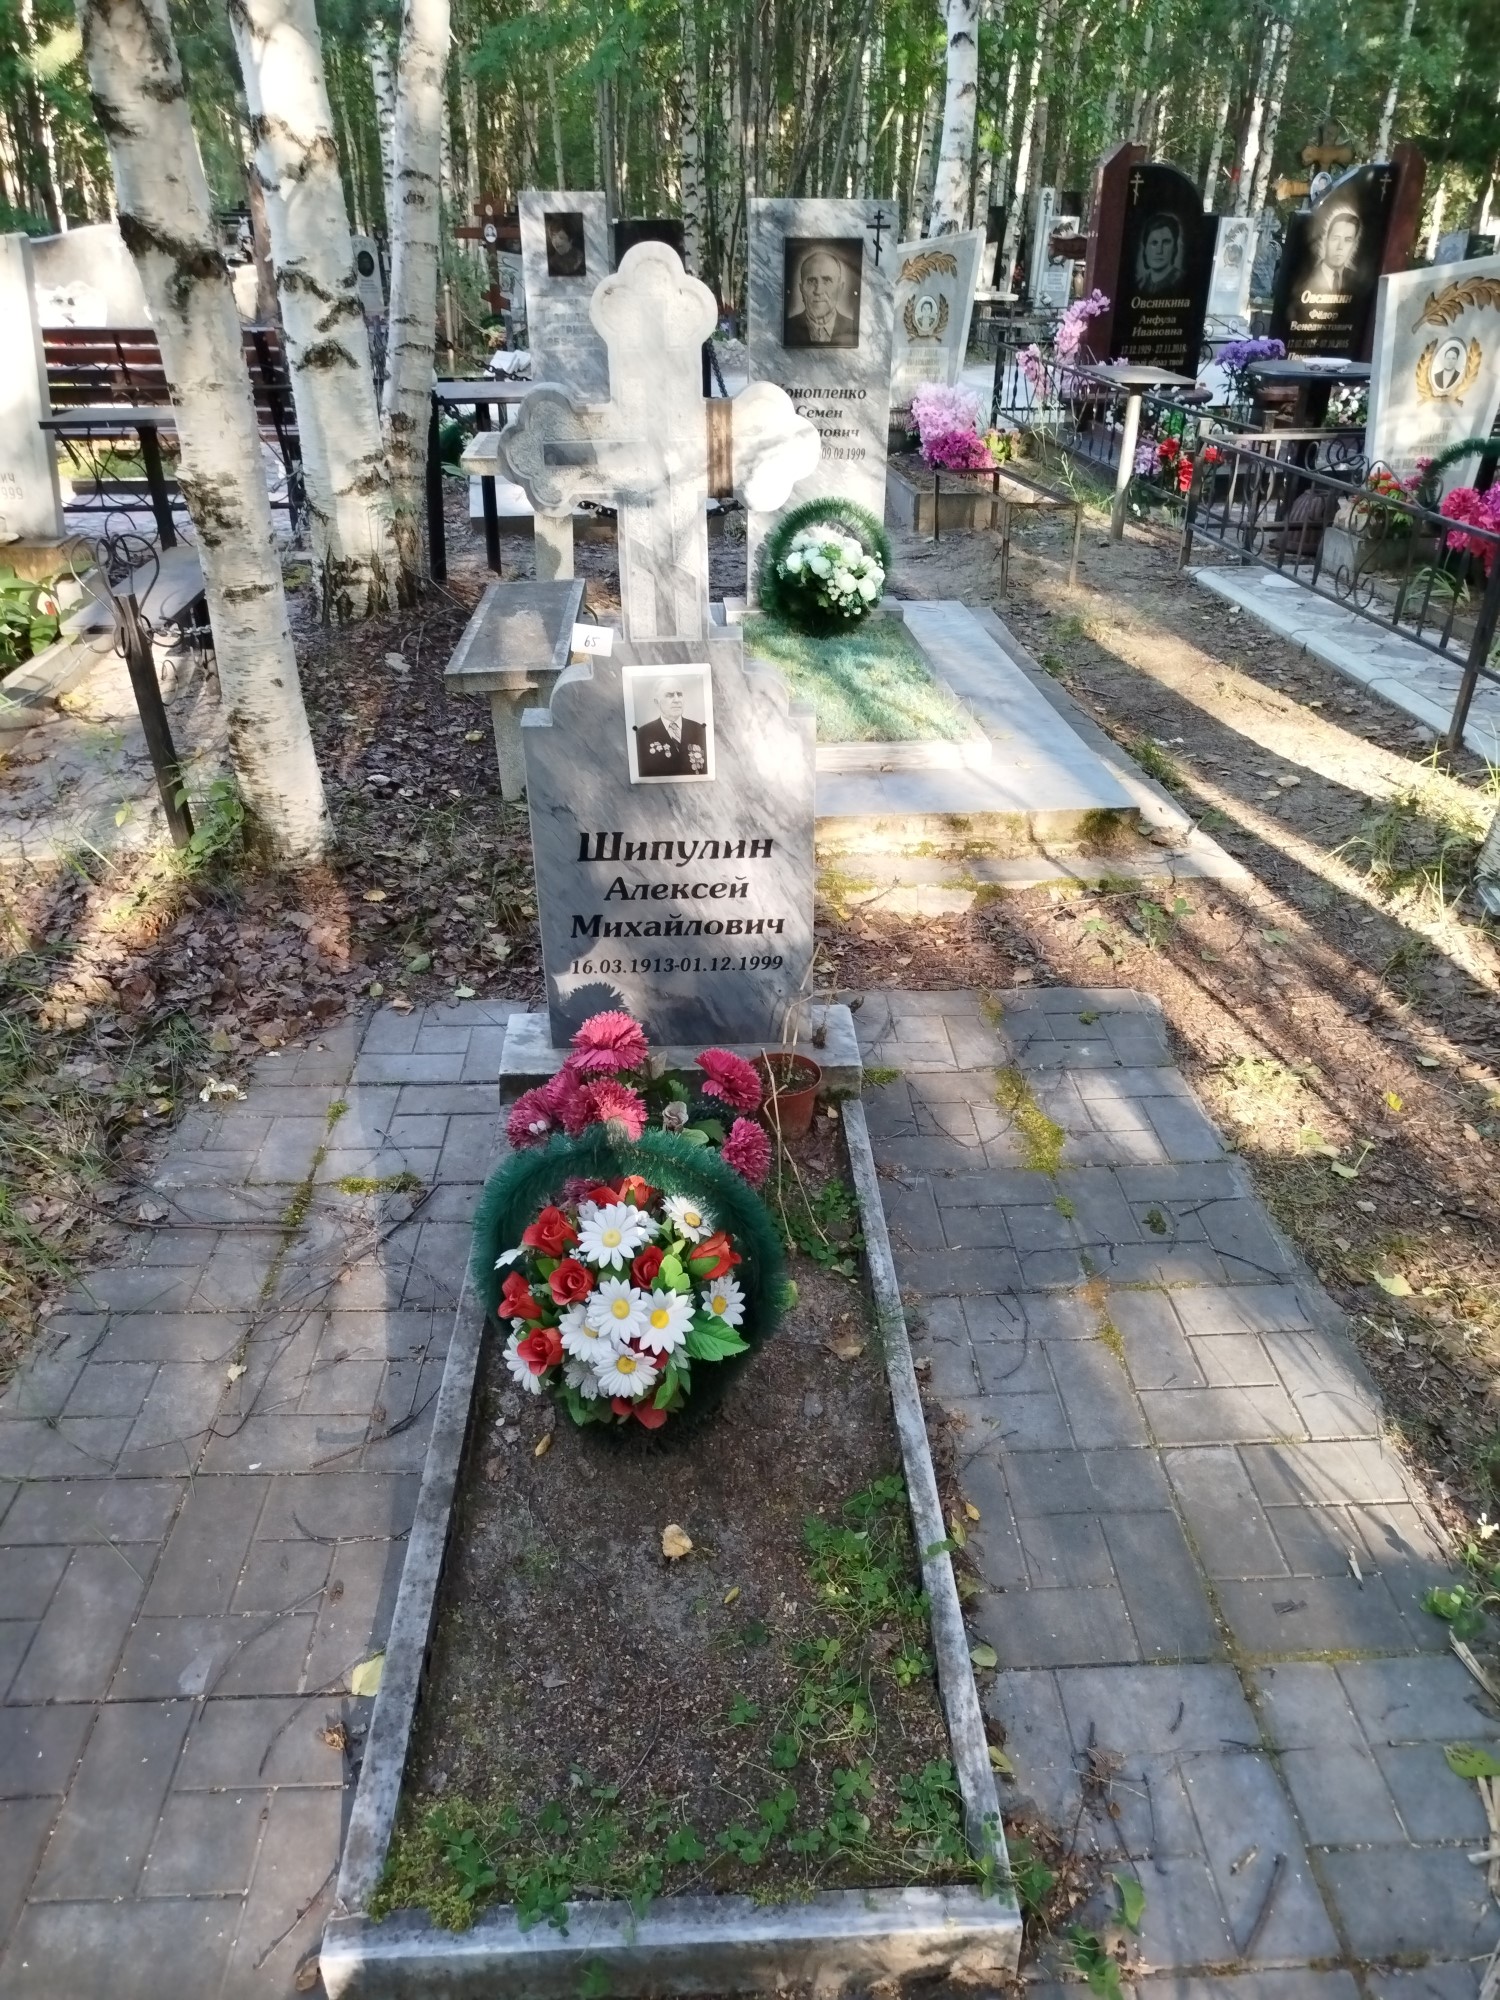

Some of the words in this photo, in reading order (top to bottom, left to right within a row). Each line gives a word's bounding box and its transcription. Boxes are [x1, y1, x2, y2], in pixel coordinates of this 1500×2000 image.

[1131, 296, 1190, 309] Овсянкина
[1132, 327, 1183, 337] Ивановна
[796, 405, 843, 418] Семен
[584, 635, 600, 648] 65
[577, 832, 774, 867] Шипулин
[604, 876, 749, 900] Алексей
[570, 914, 785, 938] Михайлович
[571, 956, 783, 975] 16.03.1913-01.12.1999
